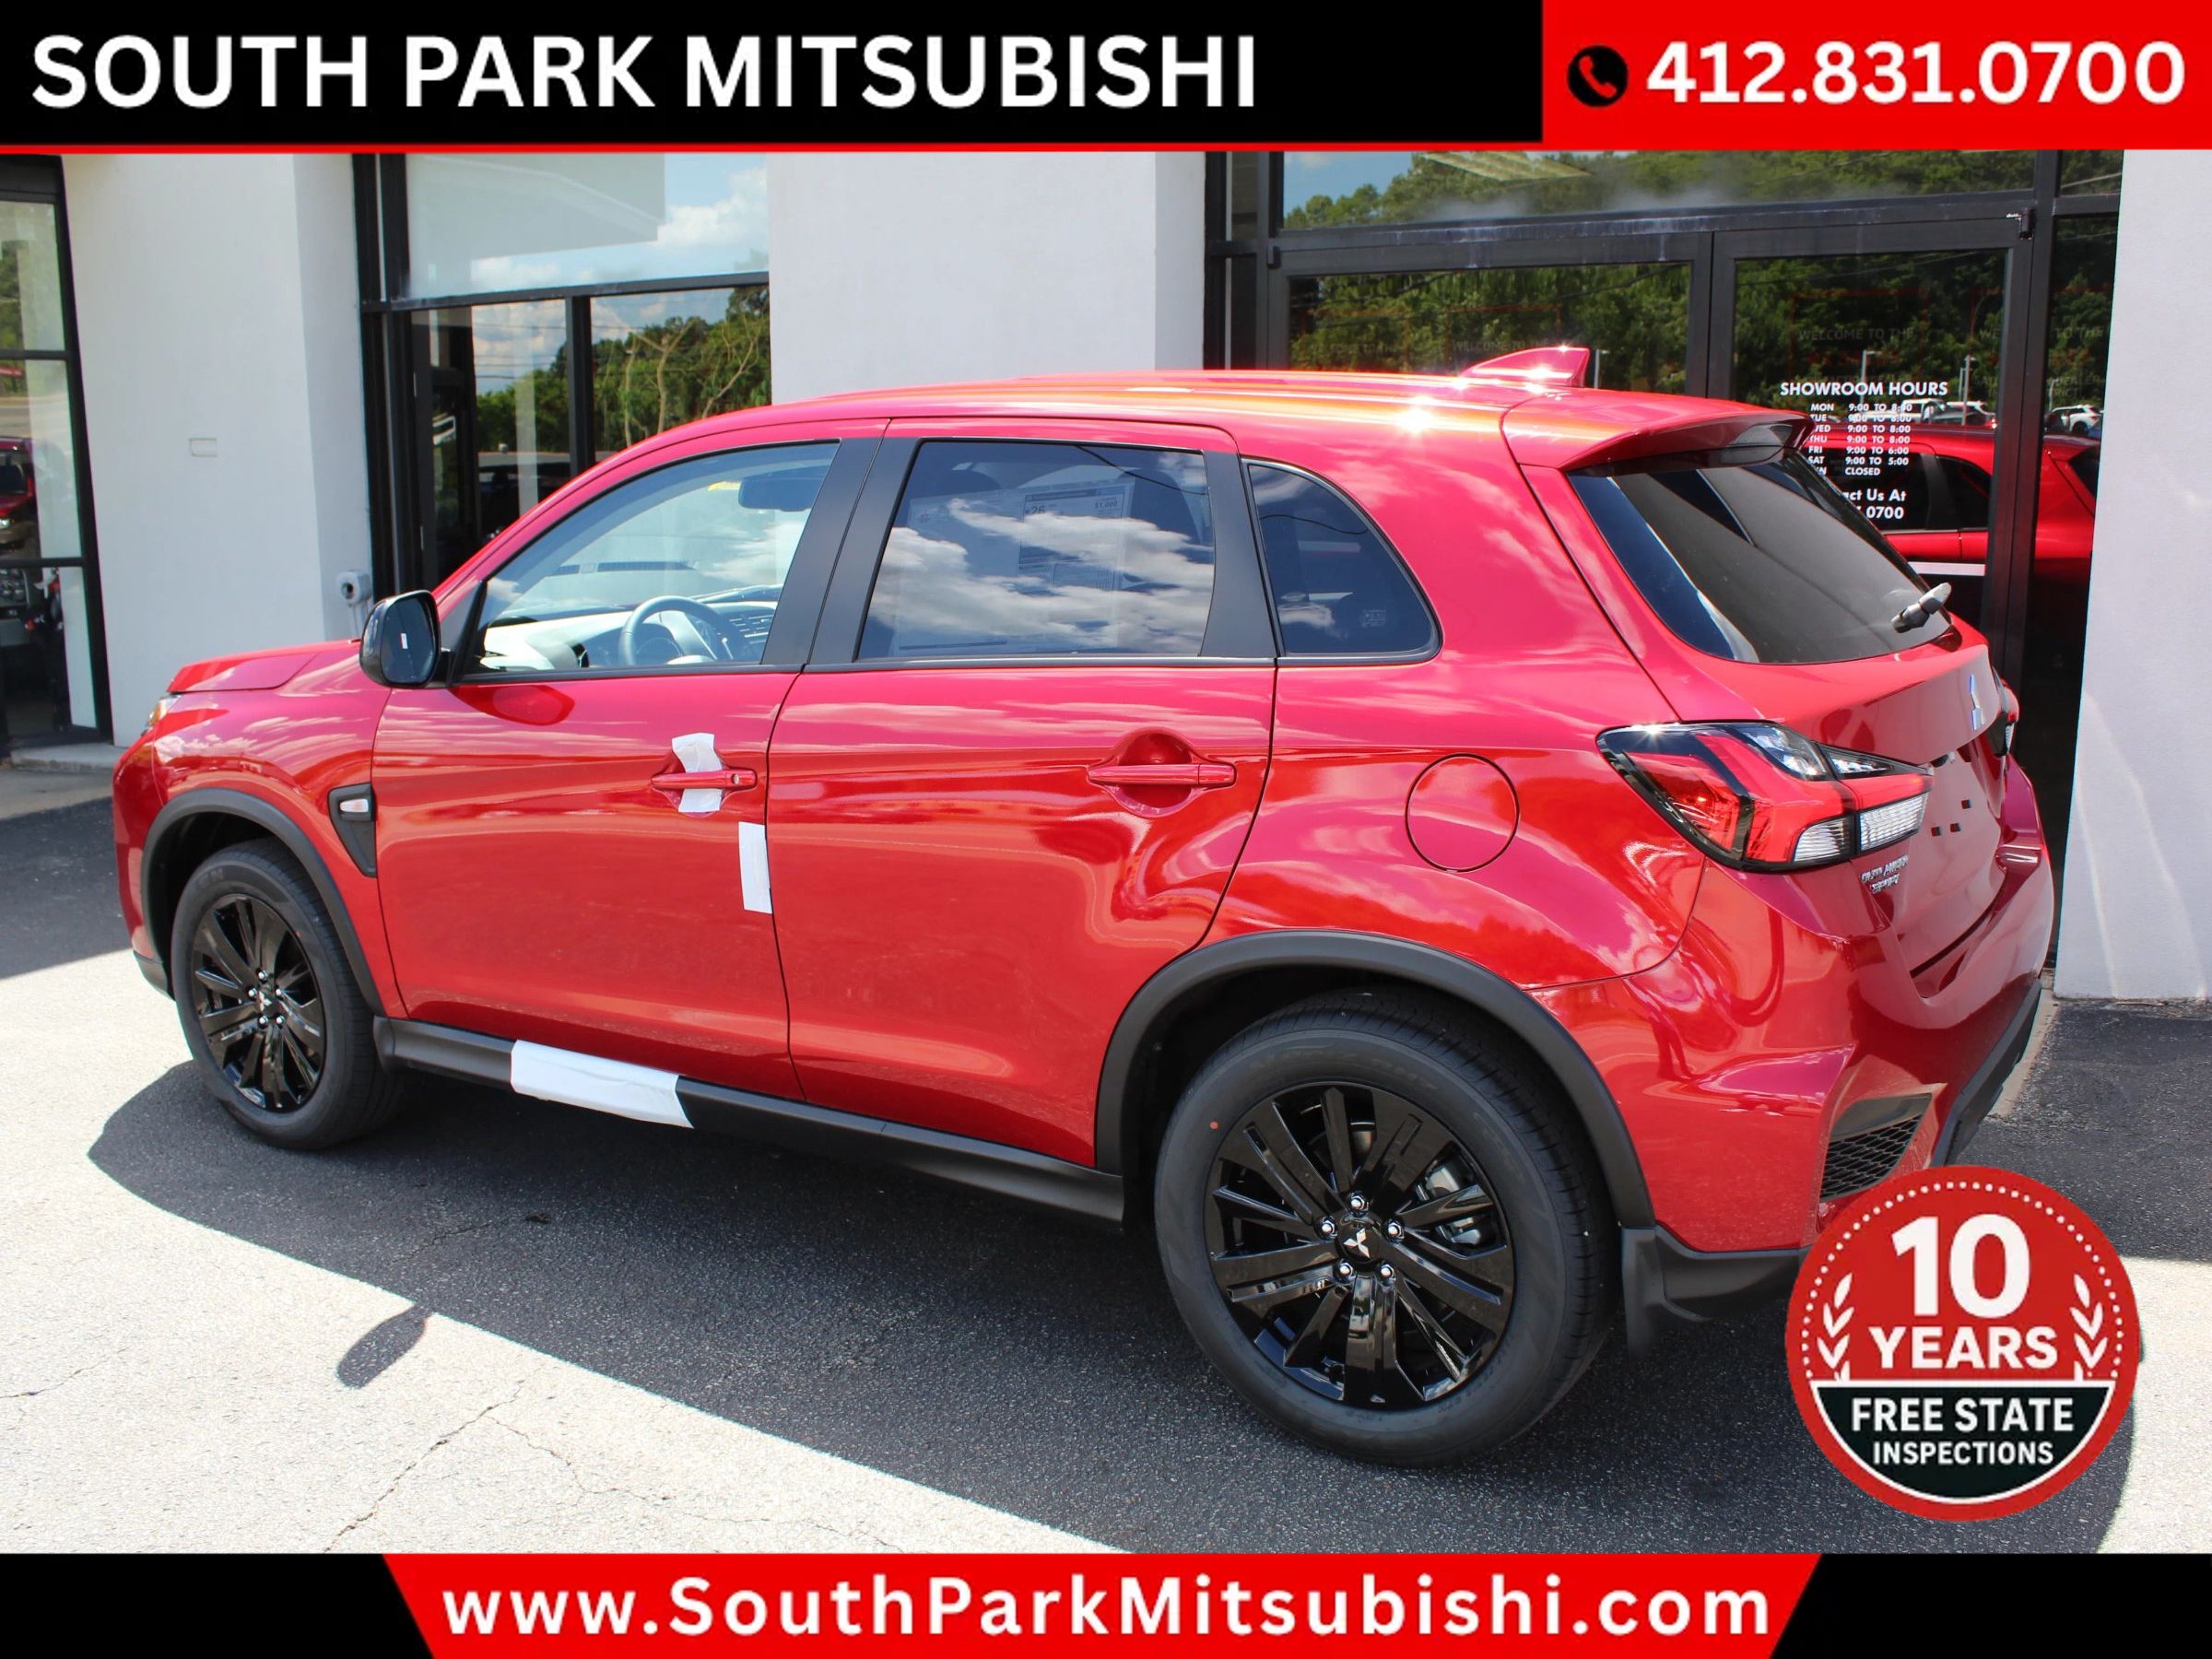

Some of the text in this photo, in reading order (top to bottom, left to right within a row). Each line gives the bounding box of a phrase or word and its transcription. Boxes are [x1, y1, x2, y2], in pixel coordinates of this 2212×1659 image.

[1780, 381, 1948, 396] SHOWROOM HOURS
[1810, 404, 1912, 412] MON 9:00 TO 8:00
[1809, 414, 1827, 422] TUE
[1873, 414, 1886, 422] TO
[1847, 425, 1867, 433] 9:00
[1873, 425, 1886, 433] TO
[1889, 425, 1911, 433] 8:00
[1845, 457, 1865, 465] 9:00
[1869, 457, 1882, 465] TO
[1888, 457, 1909, 465] 5:00
[1845, 467, 1881, 476] CLOSED
[1866, 488, 1884, 501] Us
[1889, 489, 1906, 501] At
[1865, 506, 1904, 519] 0700
